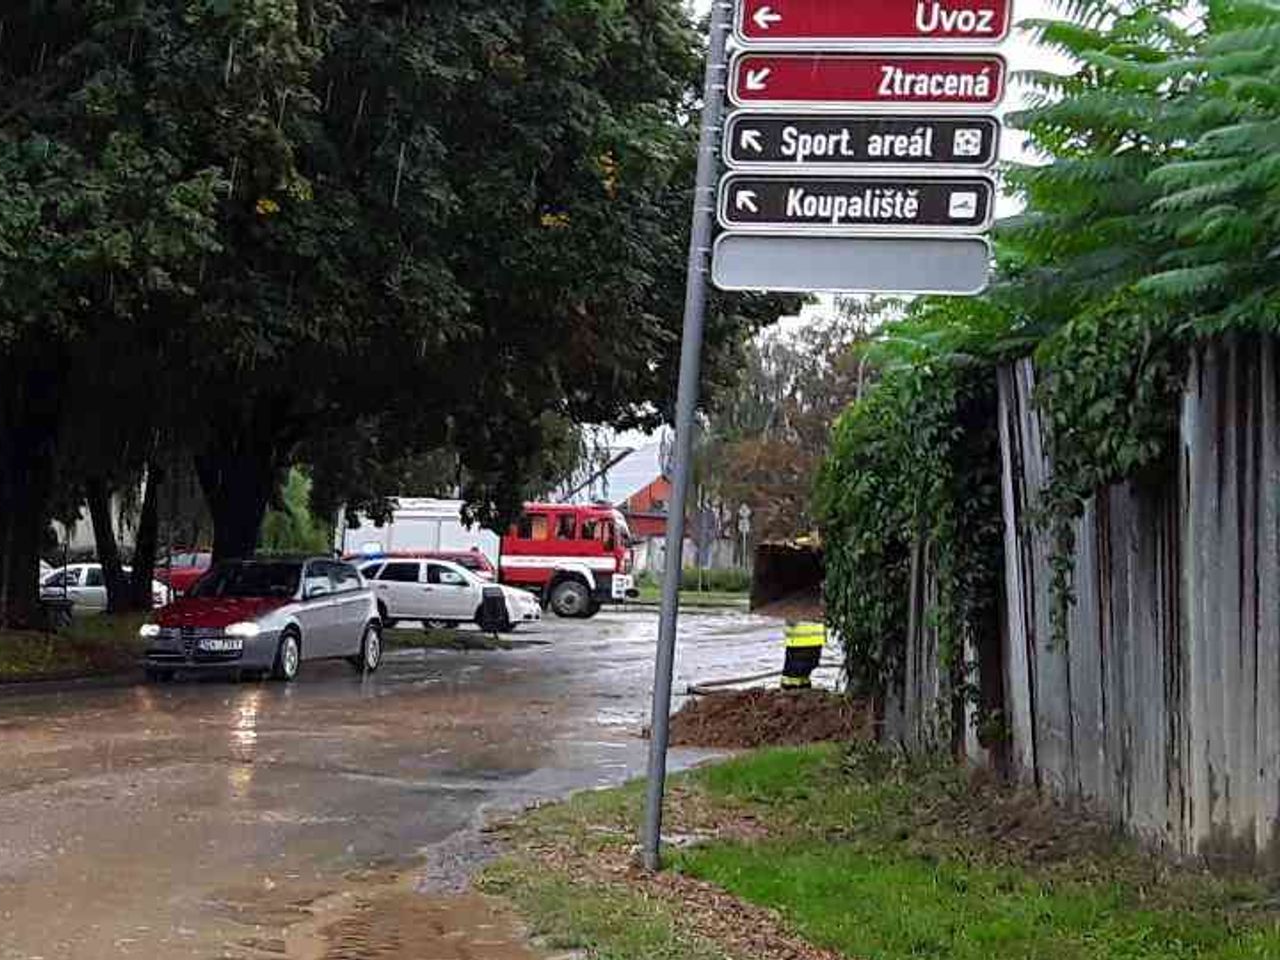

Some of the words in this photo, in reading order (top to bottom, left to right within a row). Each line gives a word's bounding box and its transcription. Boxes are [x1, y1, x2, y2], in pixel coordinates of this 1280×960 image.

[878, 66, 991, 97] Ztracená
[780, 126, 854, 163] Sport.
[868, 125, 933, 157] areál
[786, 188, 920, 223] Koupaliště
